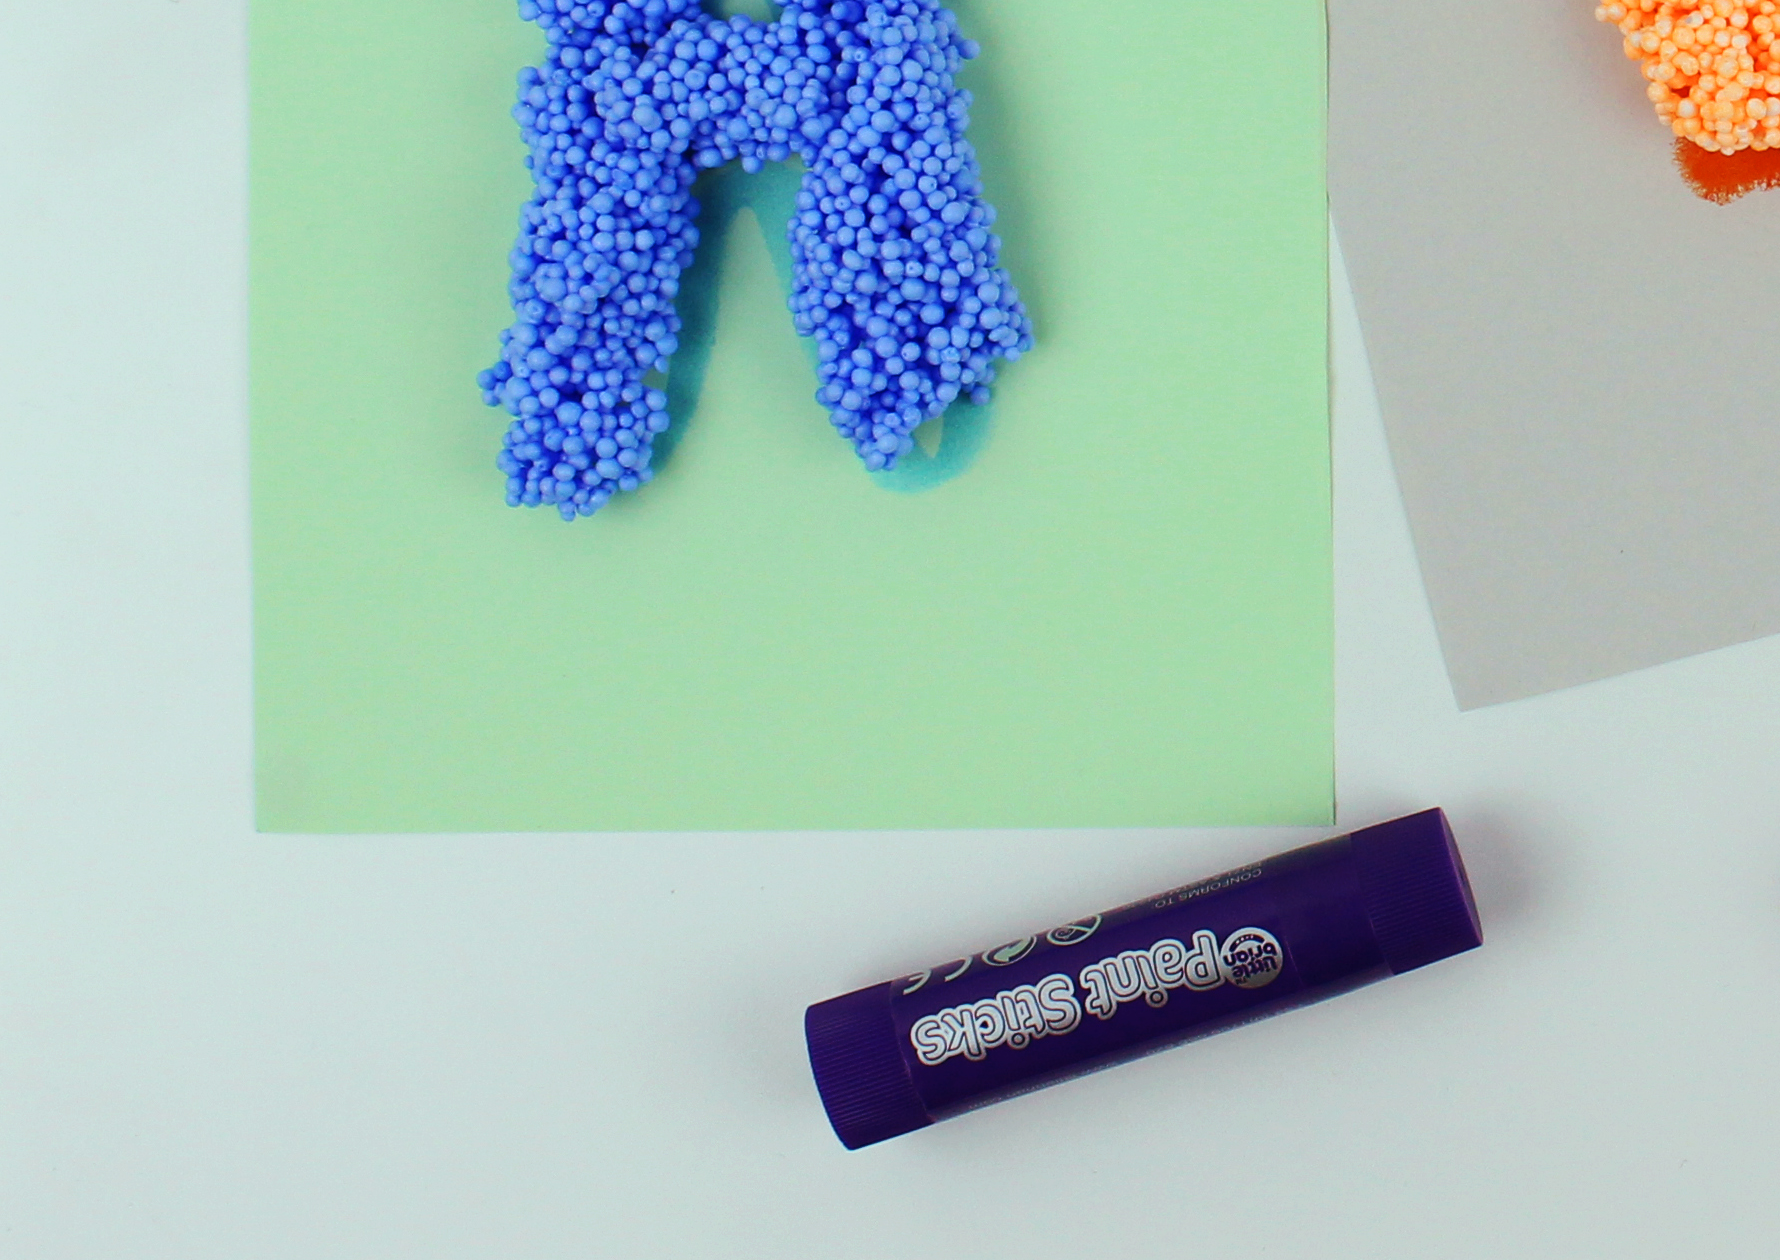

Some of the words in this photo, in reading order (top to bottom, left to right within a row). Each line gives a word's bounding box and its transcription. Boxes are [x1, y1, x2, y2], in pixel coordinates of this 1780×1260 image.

[1079, 930, 1228, 1019] Paint
[1222, 941, 1276, 969] brian
[1230, 954, 1278, 982] Little
[910, 973, 1081, 1065] Sticks
